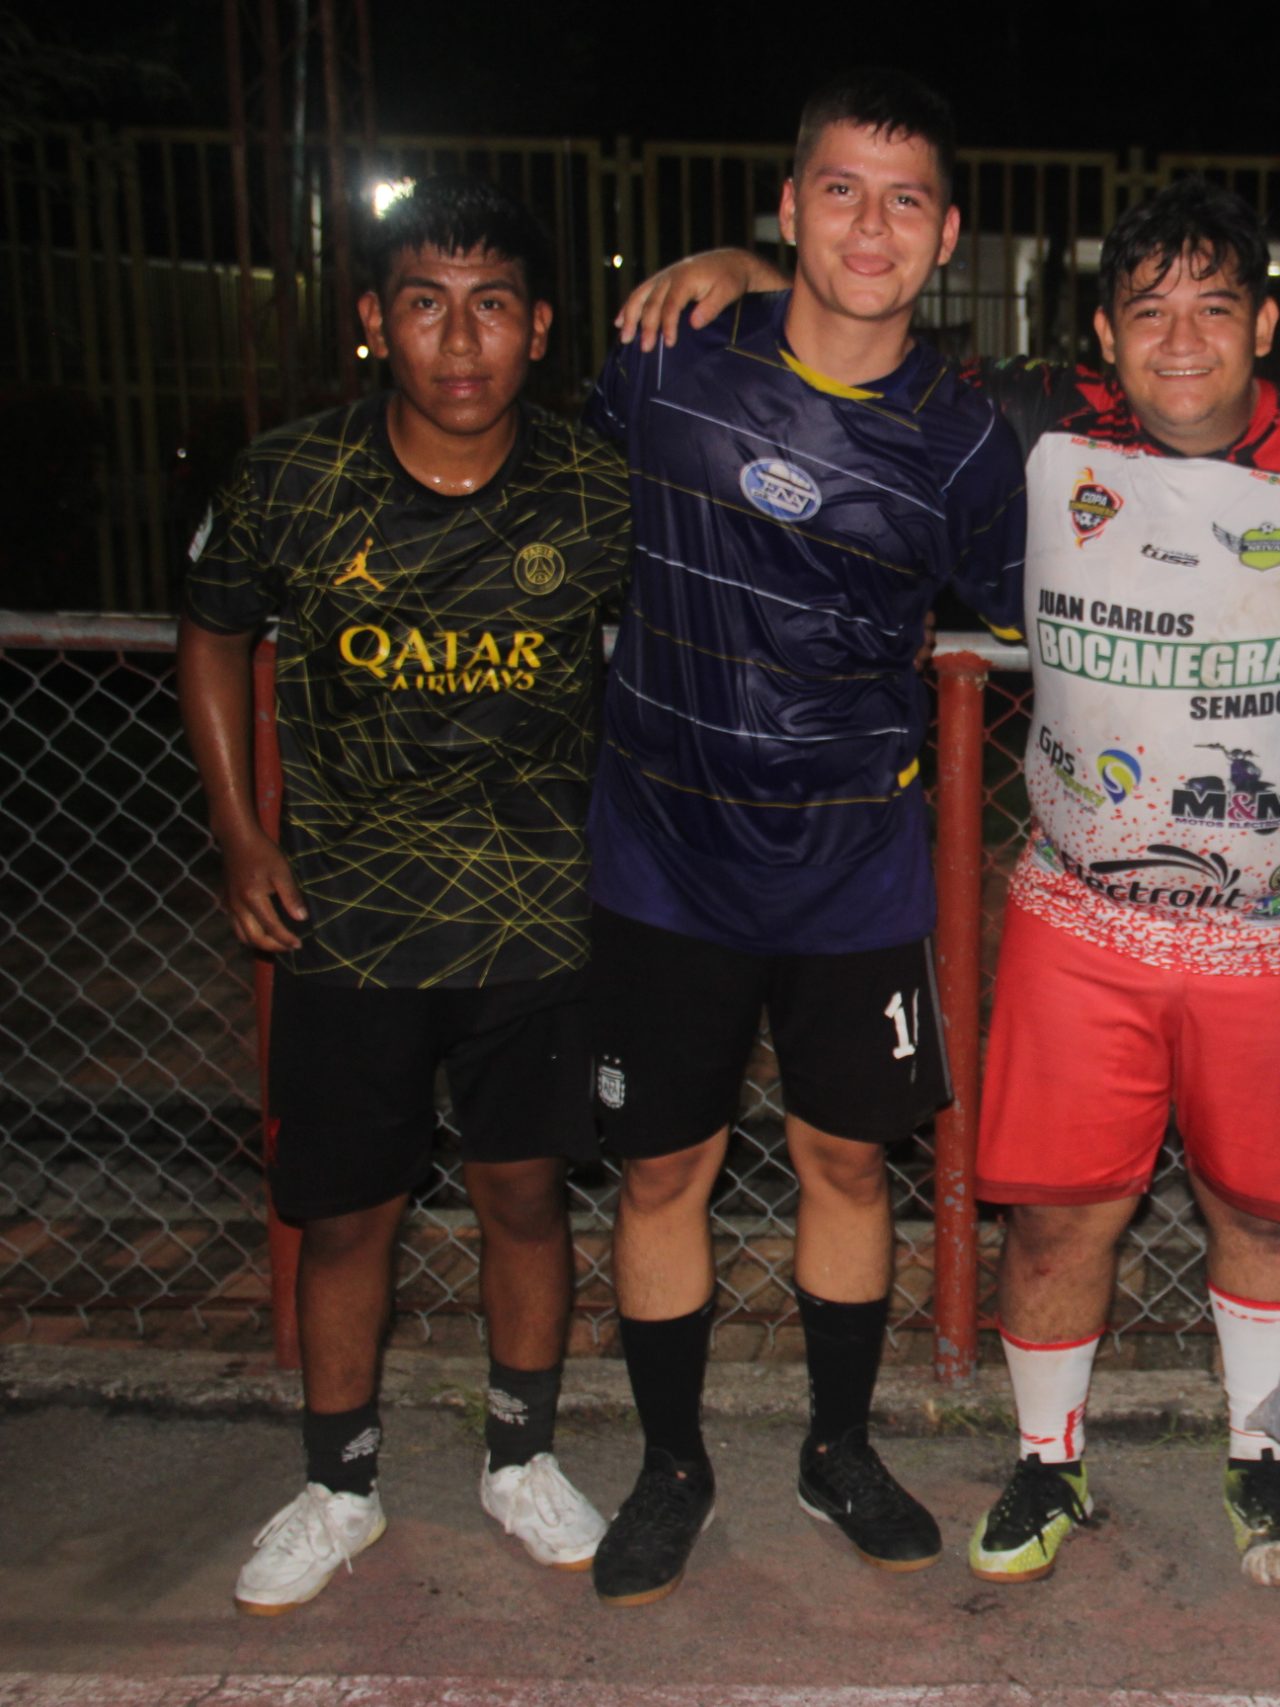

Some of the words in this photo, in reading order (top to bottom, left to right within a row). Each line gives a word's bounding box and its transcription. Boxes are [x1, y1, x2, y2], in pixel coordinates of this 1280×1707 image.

[1038, 588, 1085, 622] JUAN
[1090, 600, 1195, 637] CARLOS
[339, 624, 545, 679] QATAR
[391, 668, 535, 694] AIRWAYS
[1039, 726, 1076, 776] Gps
[1175, 817, 1224, 828] MOTOS
